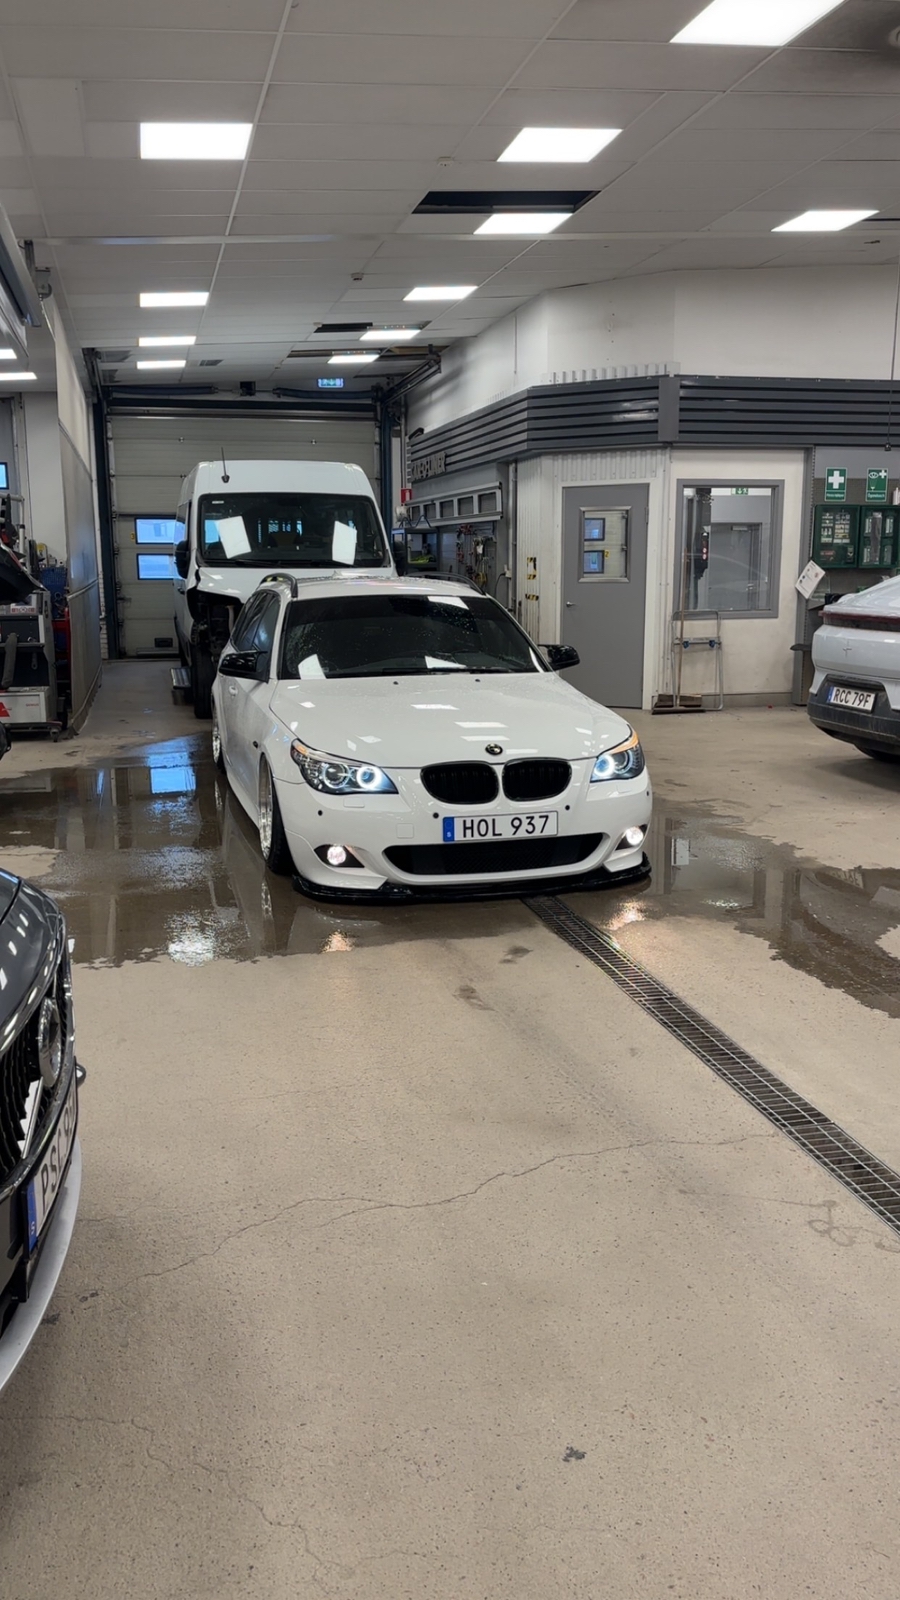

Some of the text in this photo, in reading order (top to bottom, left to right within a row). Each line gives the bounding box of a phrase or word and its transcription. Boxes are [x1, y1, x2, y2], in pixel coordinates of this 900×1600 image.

[833, 688, 871, 708] RCC 79F
[463, 818, 502, 838] HOL
[511, 815, 549, 836] 937
